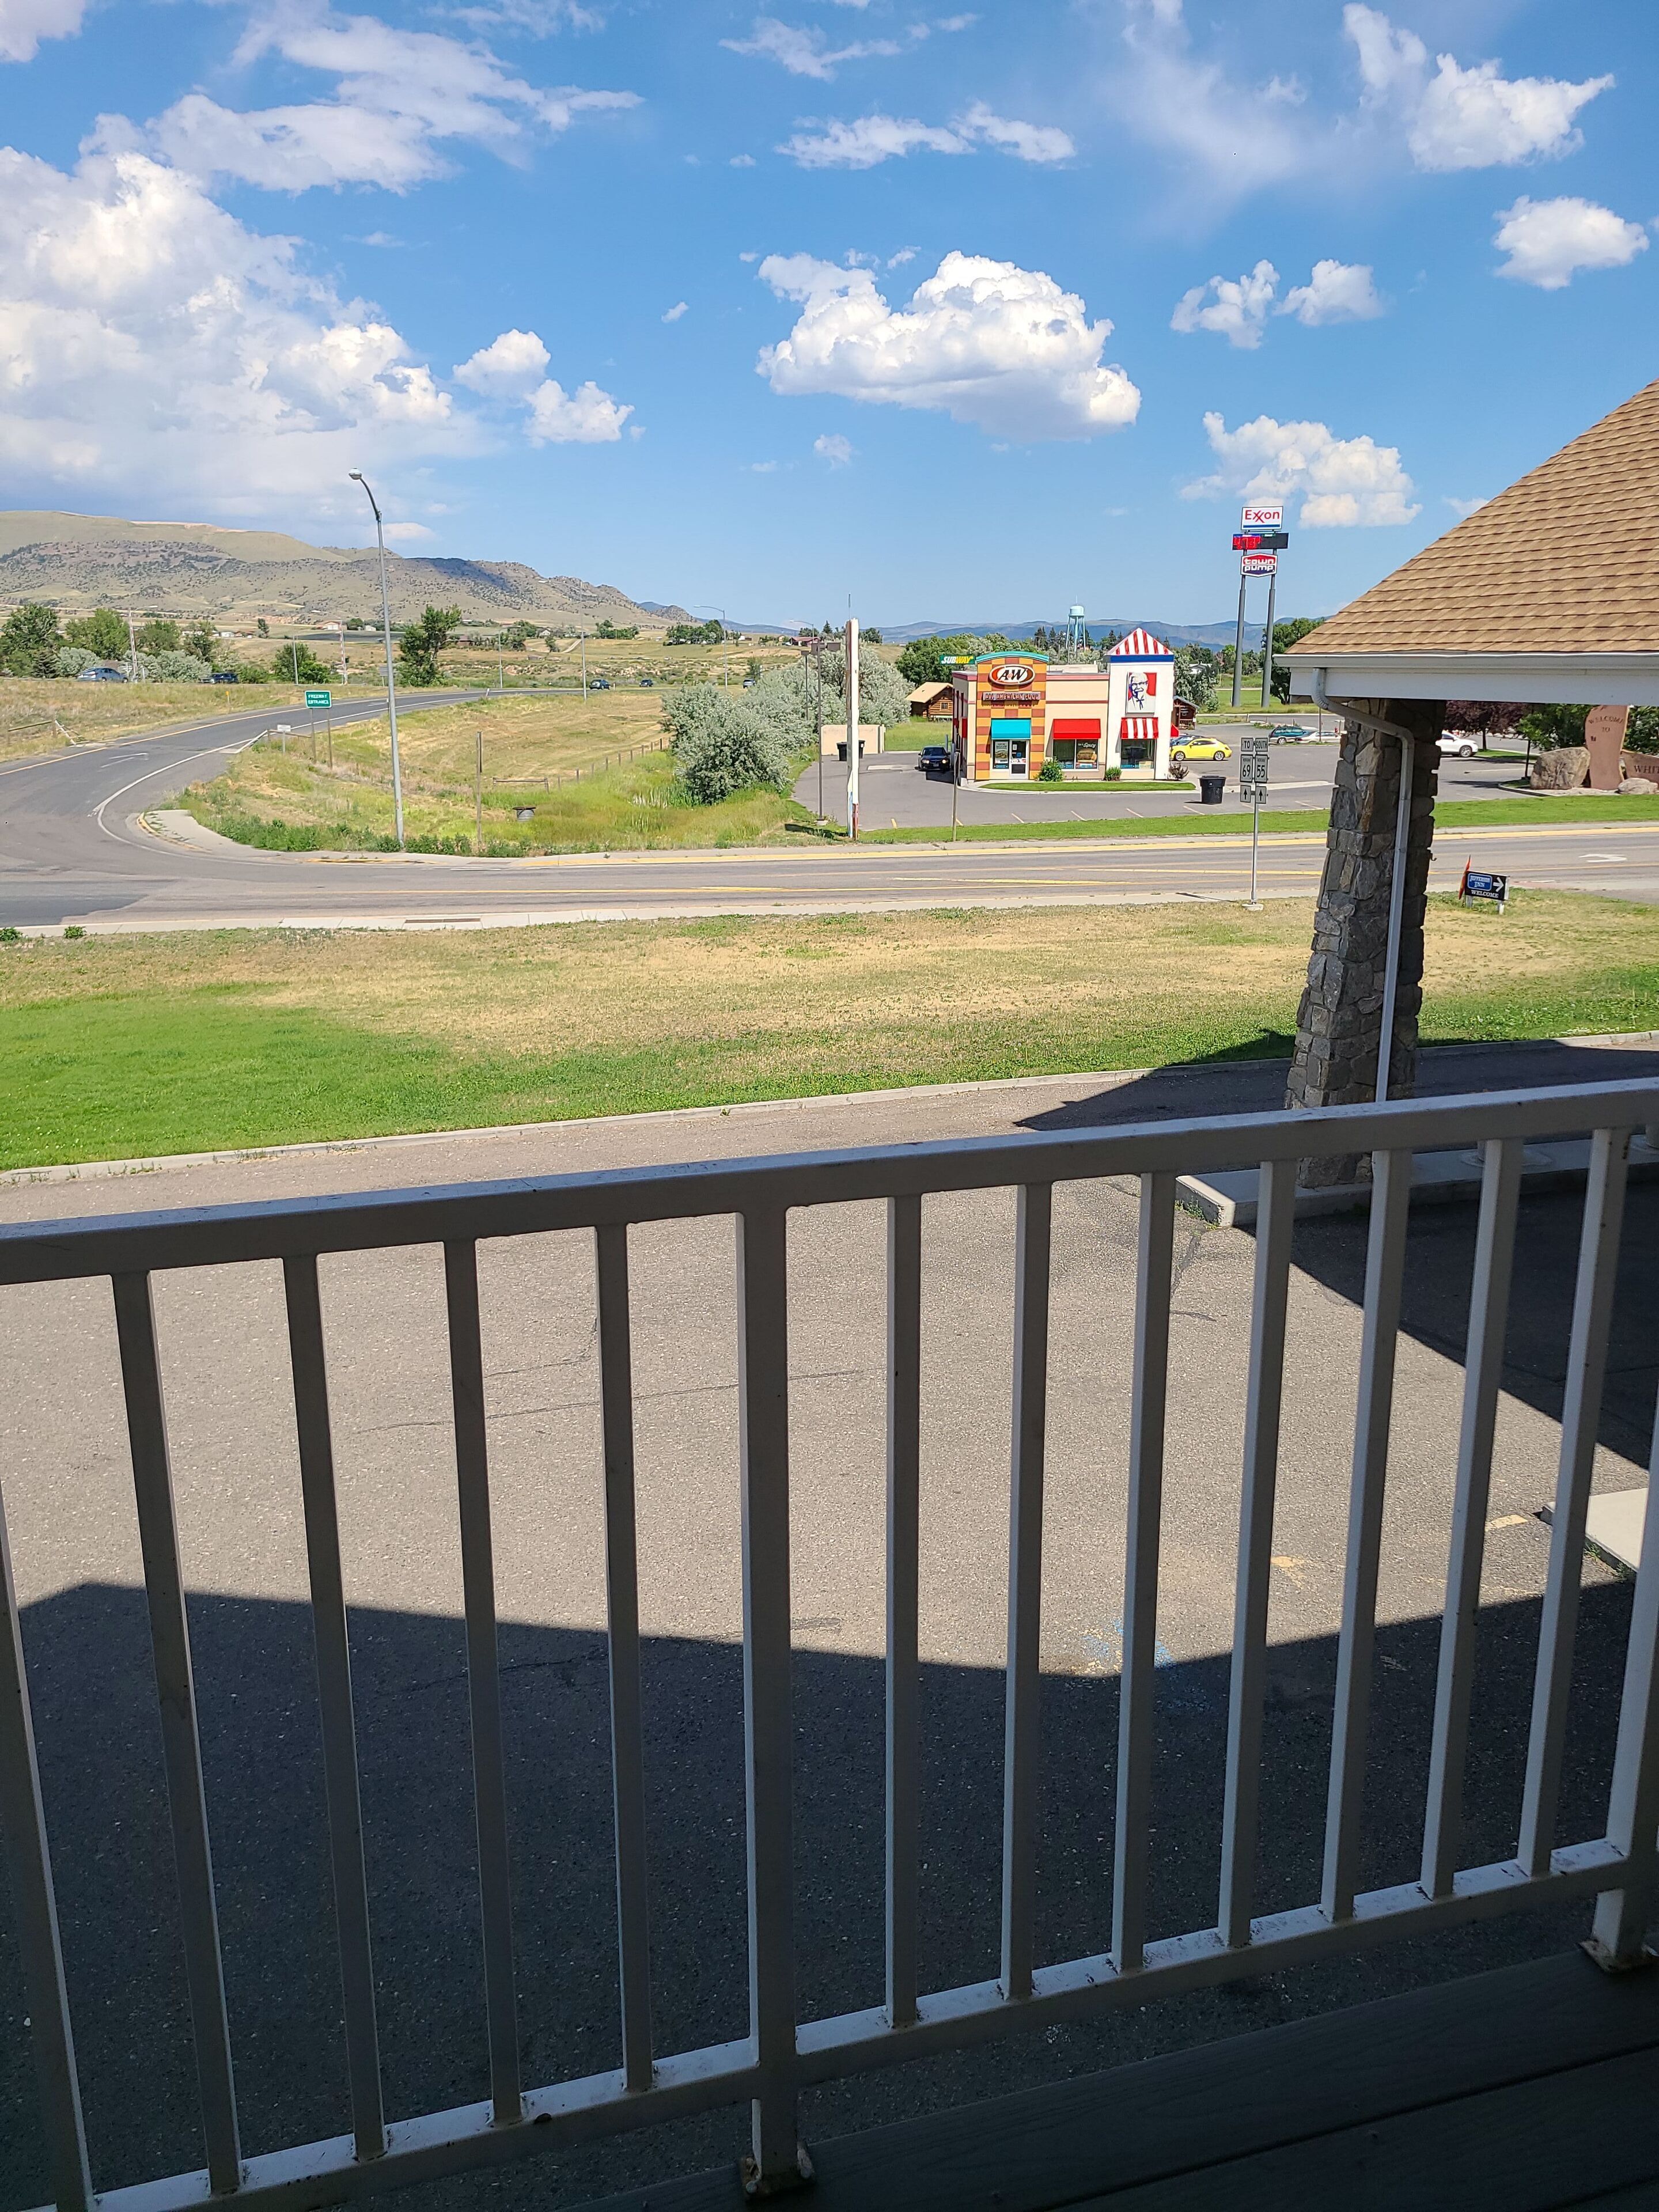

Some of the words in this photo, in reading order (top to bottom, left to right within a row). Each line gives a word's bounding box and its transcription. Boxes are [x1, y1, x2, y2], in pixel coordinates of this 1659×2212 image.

[1245, 510, 1280, 523] Exxon
[941, 656, 973, 664] SUBWAY
[1244, 740, 1251, 749] TO
[1256, 740, 1267, 749] SOUTH
[1243, 764, 1251, 777] 69
[1256, 764, 1266, 778] 55
[1471, 889, 1499, 898] WELCOME
